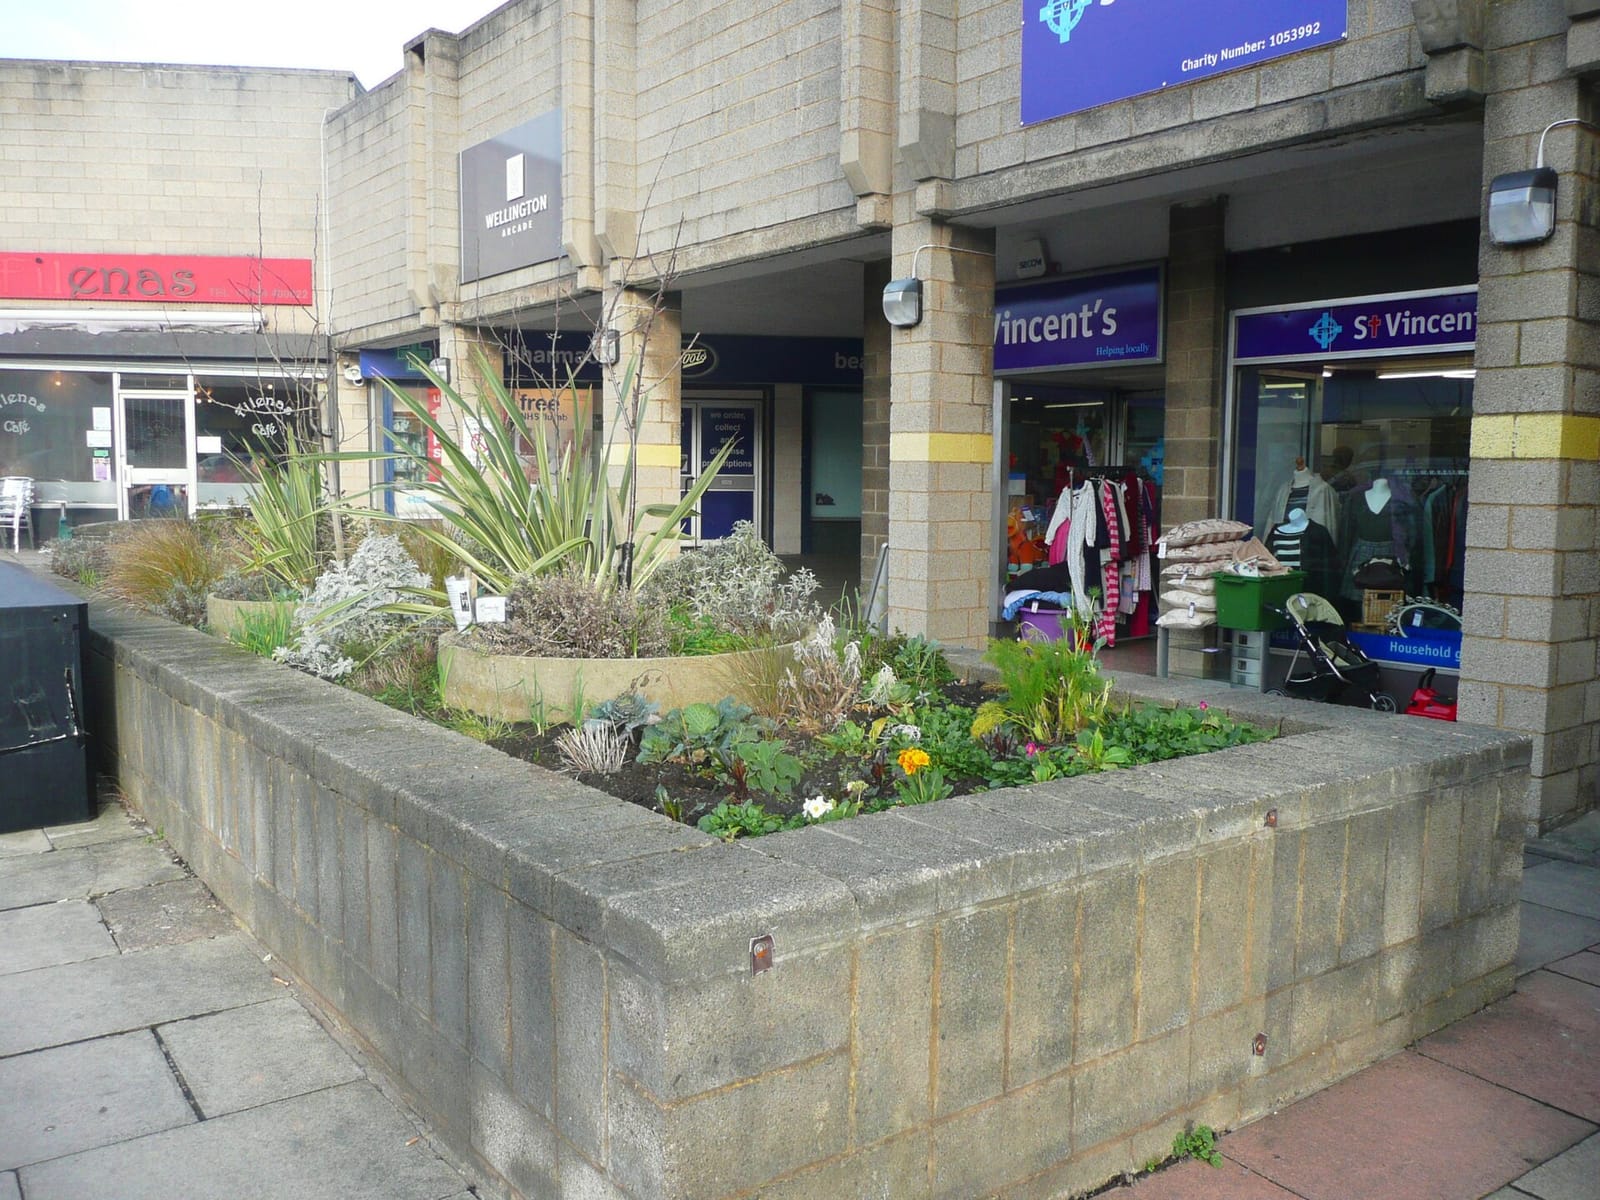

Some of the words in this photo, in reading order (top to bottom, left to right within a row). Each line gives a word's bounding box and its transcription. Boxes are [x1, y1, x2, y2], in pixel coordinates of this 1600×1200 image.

[1181, 52, 1218, 72] Charity
[1221, 39, 1266, 62] Number:
[1269, 21, 1321, 48] 1053992
[485, 194, 548, 229] WELLINGTON
[501, 220, 533, 238] ARCADE
[1385, 310, 1478, 337] Vincen
[507, 347, 604, 369] pharmac
[682, 349, 707, 368] oots
[1096, 346, 1125, 357] Helping
[1126, 343, 1150, 353] locally
[519, 394, 560, 411] free
[521, 412, 539, 421] NHS
[3, 419, 31, 435] Café
[252, 422, 278, 438] Café
[714, 423, 741, 432] collect
[709, 447, 745, 456] disnse
[702, 459, 752, 470] prriptions
[1390, 640, 1451, 658] Household
